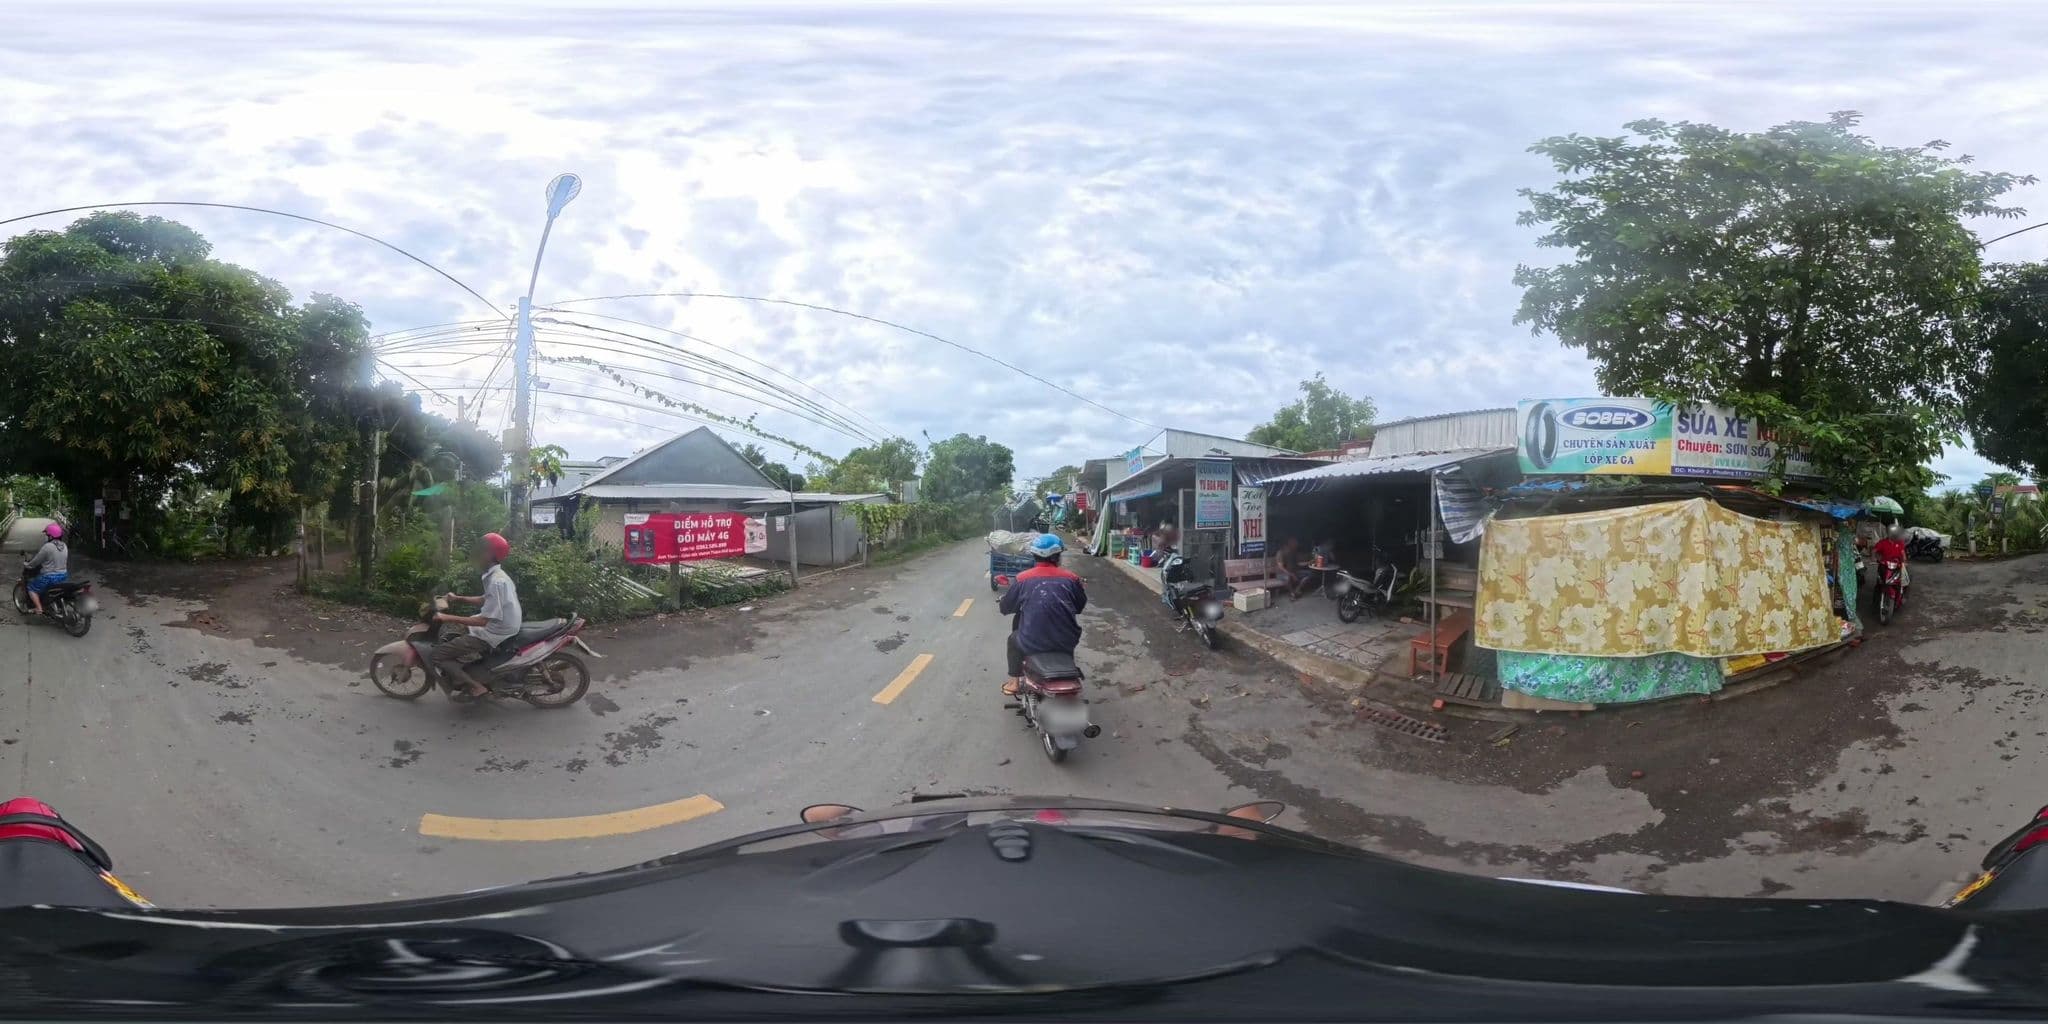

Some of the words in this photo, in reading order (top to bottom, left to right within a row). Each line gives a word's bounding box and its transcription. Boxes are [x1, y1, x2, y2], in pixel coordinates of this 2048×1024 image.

[1572, 411, 1638, 426] SOBEK
[1724, 416, 1749, 438] XE
[1563, 437, 1604, 449] CHUYÊN
[1677, 439, 1722, 455] Chuyên:
[1605, 455, 1618, 465] XE
[1620, 455, 1635, 465] GA
[697, 530, 716, 542] MÁY
[717, 531, 729, 540] 4G
